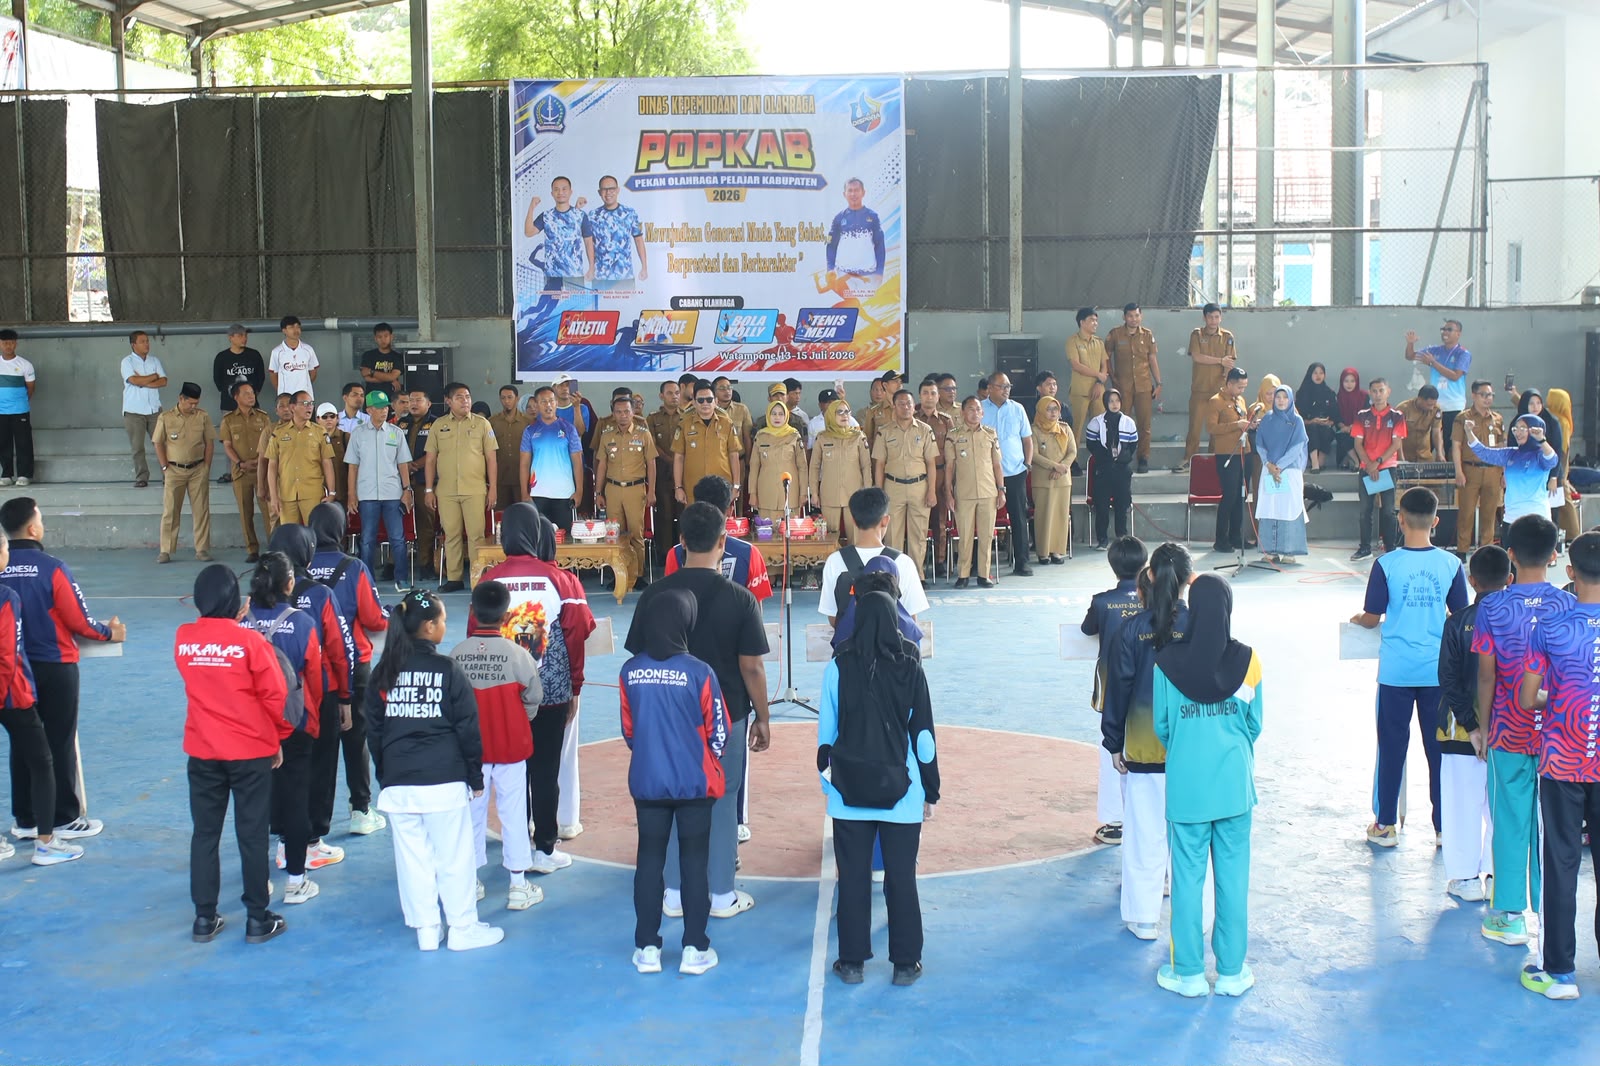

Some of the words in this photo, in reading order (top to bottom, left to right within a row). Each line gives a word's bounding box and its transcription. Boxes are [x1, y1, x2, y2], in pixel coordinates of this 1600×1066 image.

[638, 95, 669, 115] DINAS
[671, 95, 738, 115] KEPEMUDAAN
[740, 95, 762, 114] DAN
[763, 95, 816, 114] OLAHRAGA
[635, 129, 817, 173] POPKAB
[634, 176, 666, 188] PEKAN
[668, 175, 719, 186] OLAHRAGA
[720, 175, 760, 185] PELAJAR
[762, 175, 818, 187] KABUPATEN
[713, 189, 740, 201] 2026
[645, 222, 702, 248] Mewujudkan
[704, 222, 745, 243] Generasi
[747, 222, 773, 243] Muda
[774, 222, 797, 247] Yang
[667, 252, 721, 279] Berprestasi
[722, 252, 740, 273] dan
[678, 298, 703, 308] CABANG
[703, 298, 735, 308] OLAHRAGA
[648, 320, 687, 334] KARATE
[732, 315, 767, 326] BOLA
[812, 315, 848, 326] TENIS
[567, 320, 609, 335] ATLETIK
[728, 326, 766, 337] VOLLY
[804, 327, 837, 338] MEJA
[720, 351, 779, 362] Watampone,
[779, 351, 808, 360] 13-15
[809, 351, 828, 360] Juli
[829, 351, 855, 360] 2026
[0, 565, 39, 574] ONESIA
[455, 654, 487, 663] KUSHIN
[489, 654, 508, 663] RYU
[464, 663, 503, 672] KARATE-DO
[395, 672, 412, 687] HIN
[413, 672, 430, 687] RYU
[433, 672, 443, 687] M
[465, 673, 507, 681] ONESIA
[628, 668, 688, 682] INDONESIA
[386, 688, 418, 703] ARATE
[385, 703, 442, 718] NDONESIA
[1180, 703, 1201, 719] SMPN
[1586, 695, 1600, 758] RUNNERS
